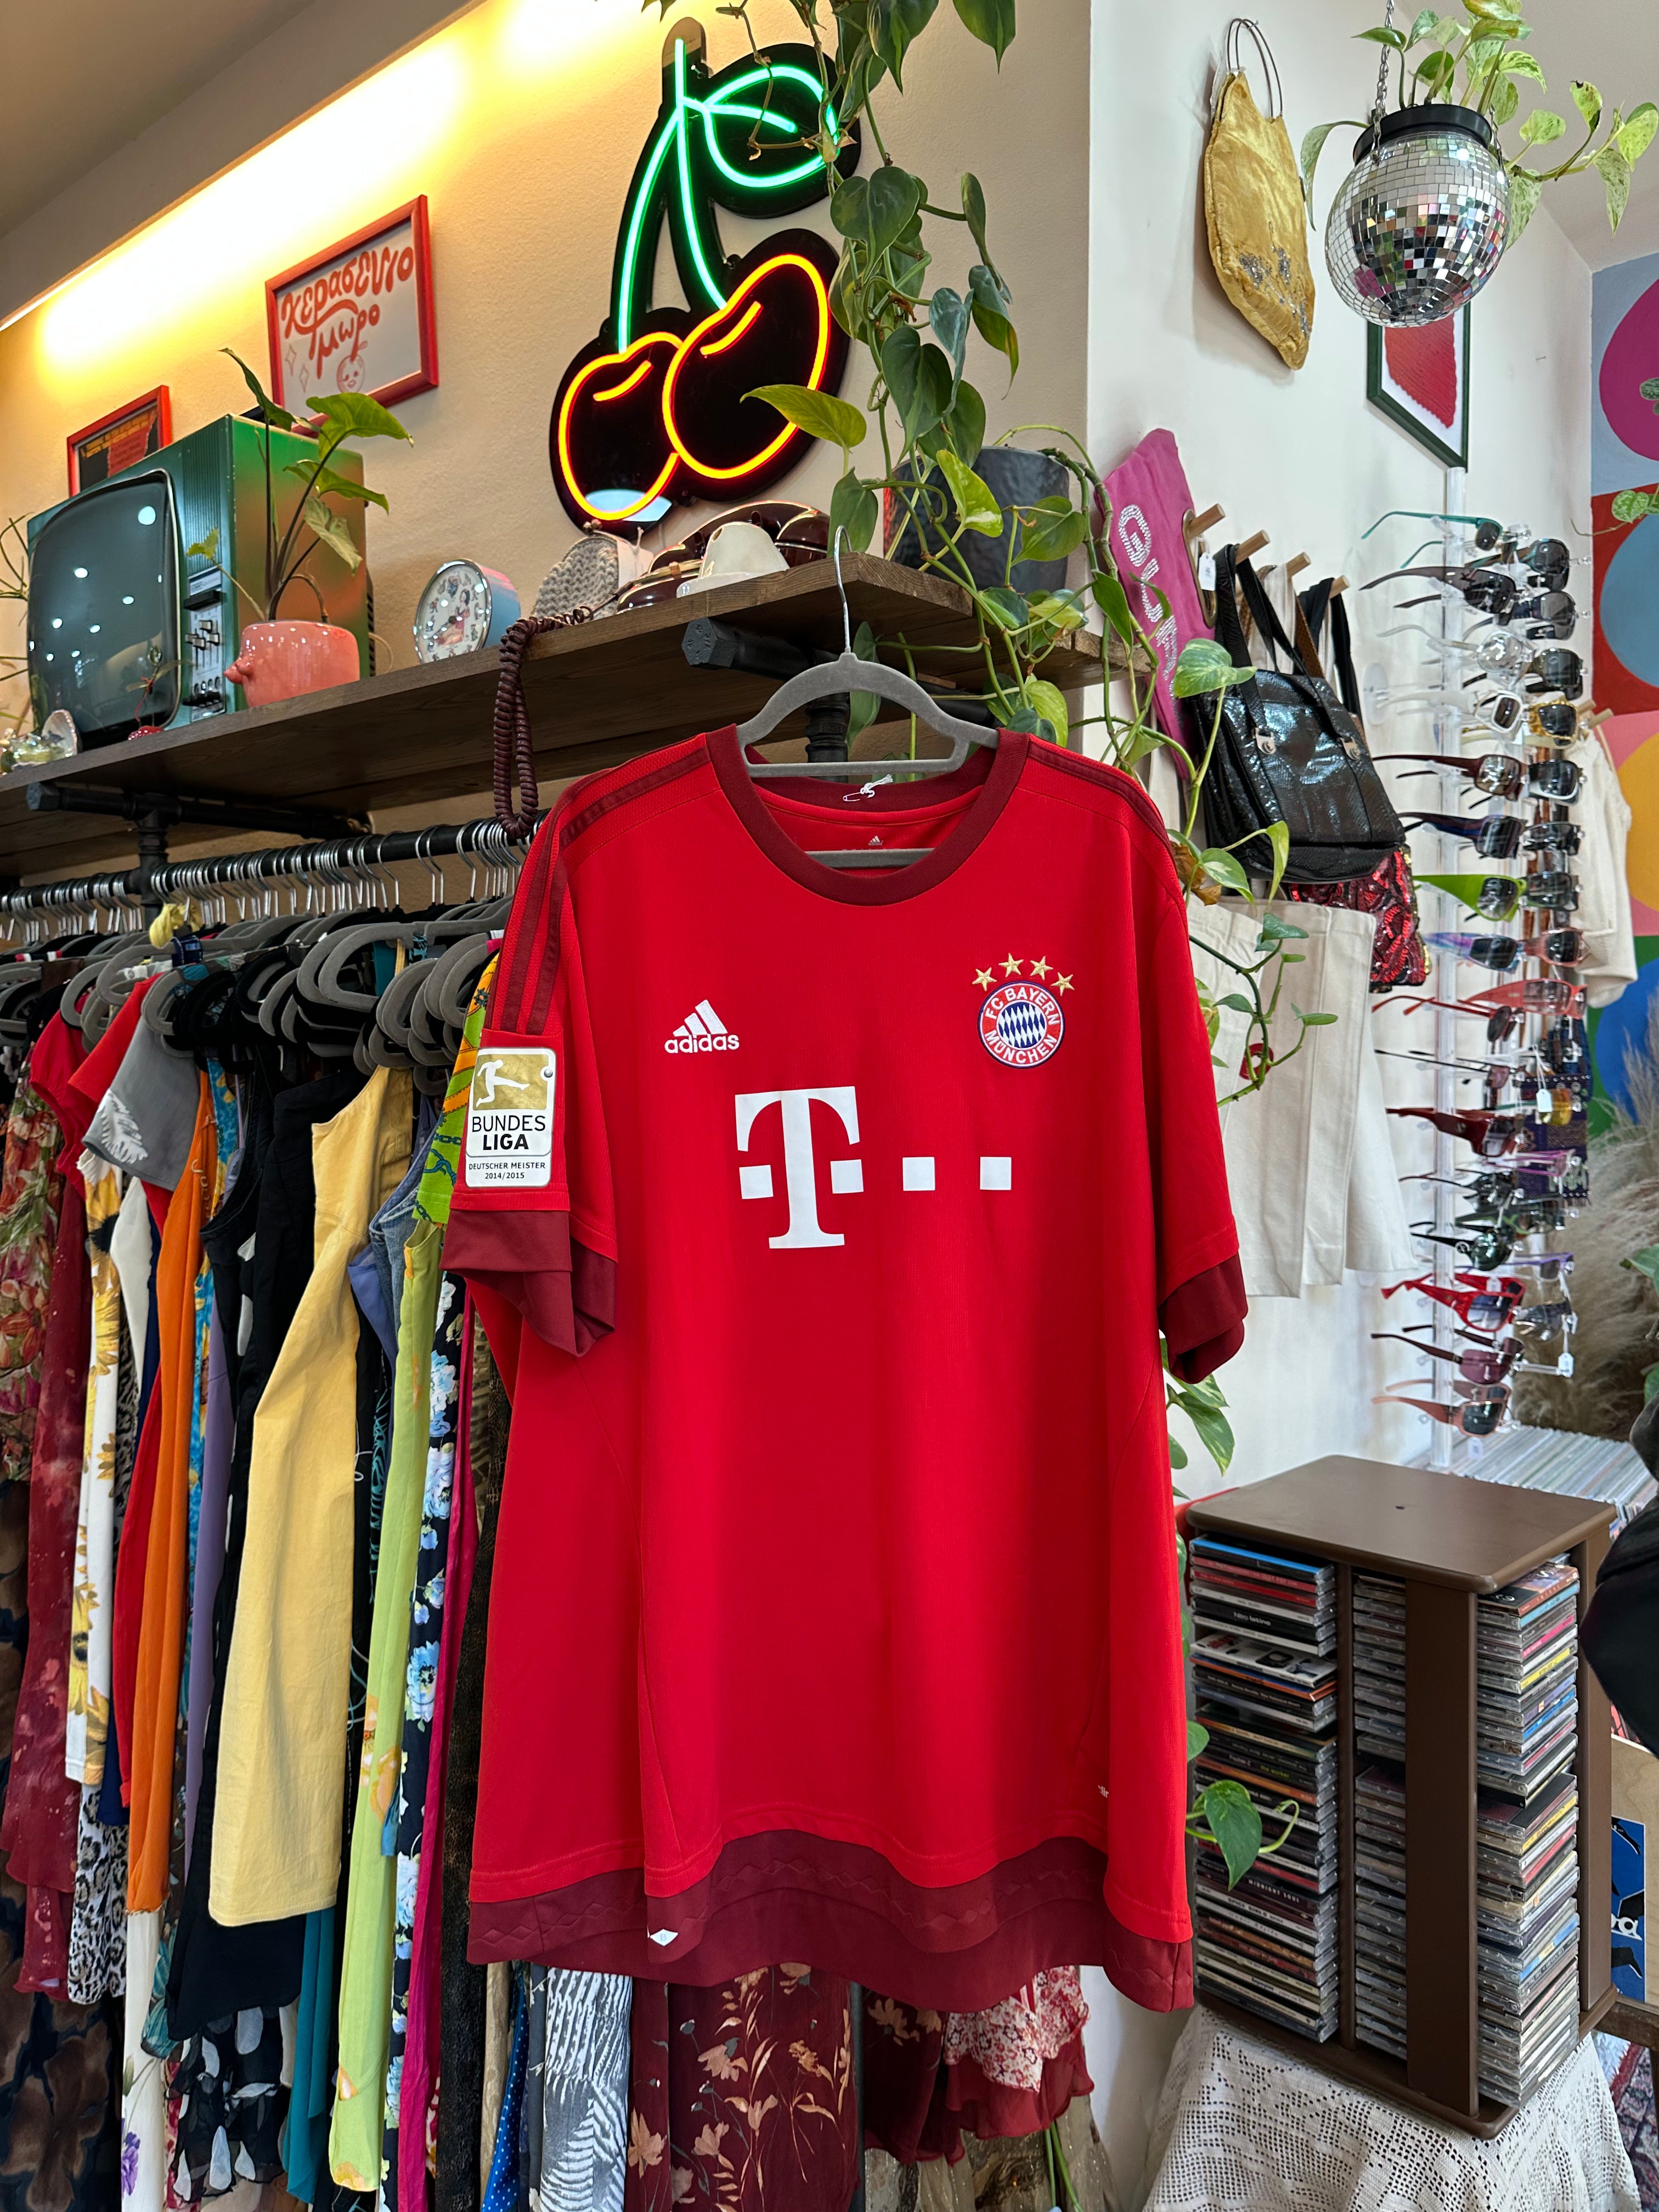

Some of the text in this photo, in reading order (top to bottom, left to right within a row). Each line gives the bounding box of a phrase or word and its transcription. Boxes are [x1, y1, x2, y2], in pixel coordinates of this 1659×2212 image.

[985, 987, 1059, 1025] FC BAYERN
[664, 1034, 740, 1053] adidas
[985, 1030, 1057, 1063] MÜNCHEN
[472, 1115, 546, 1132] BUNDES
[483, 1133, 529, 1150] LIGA
